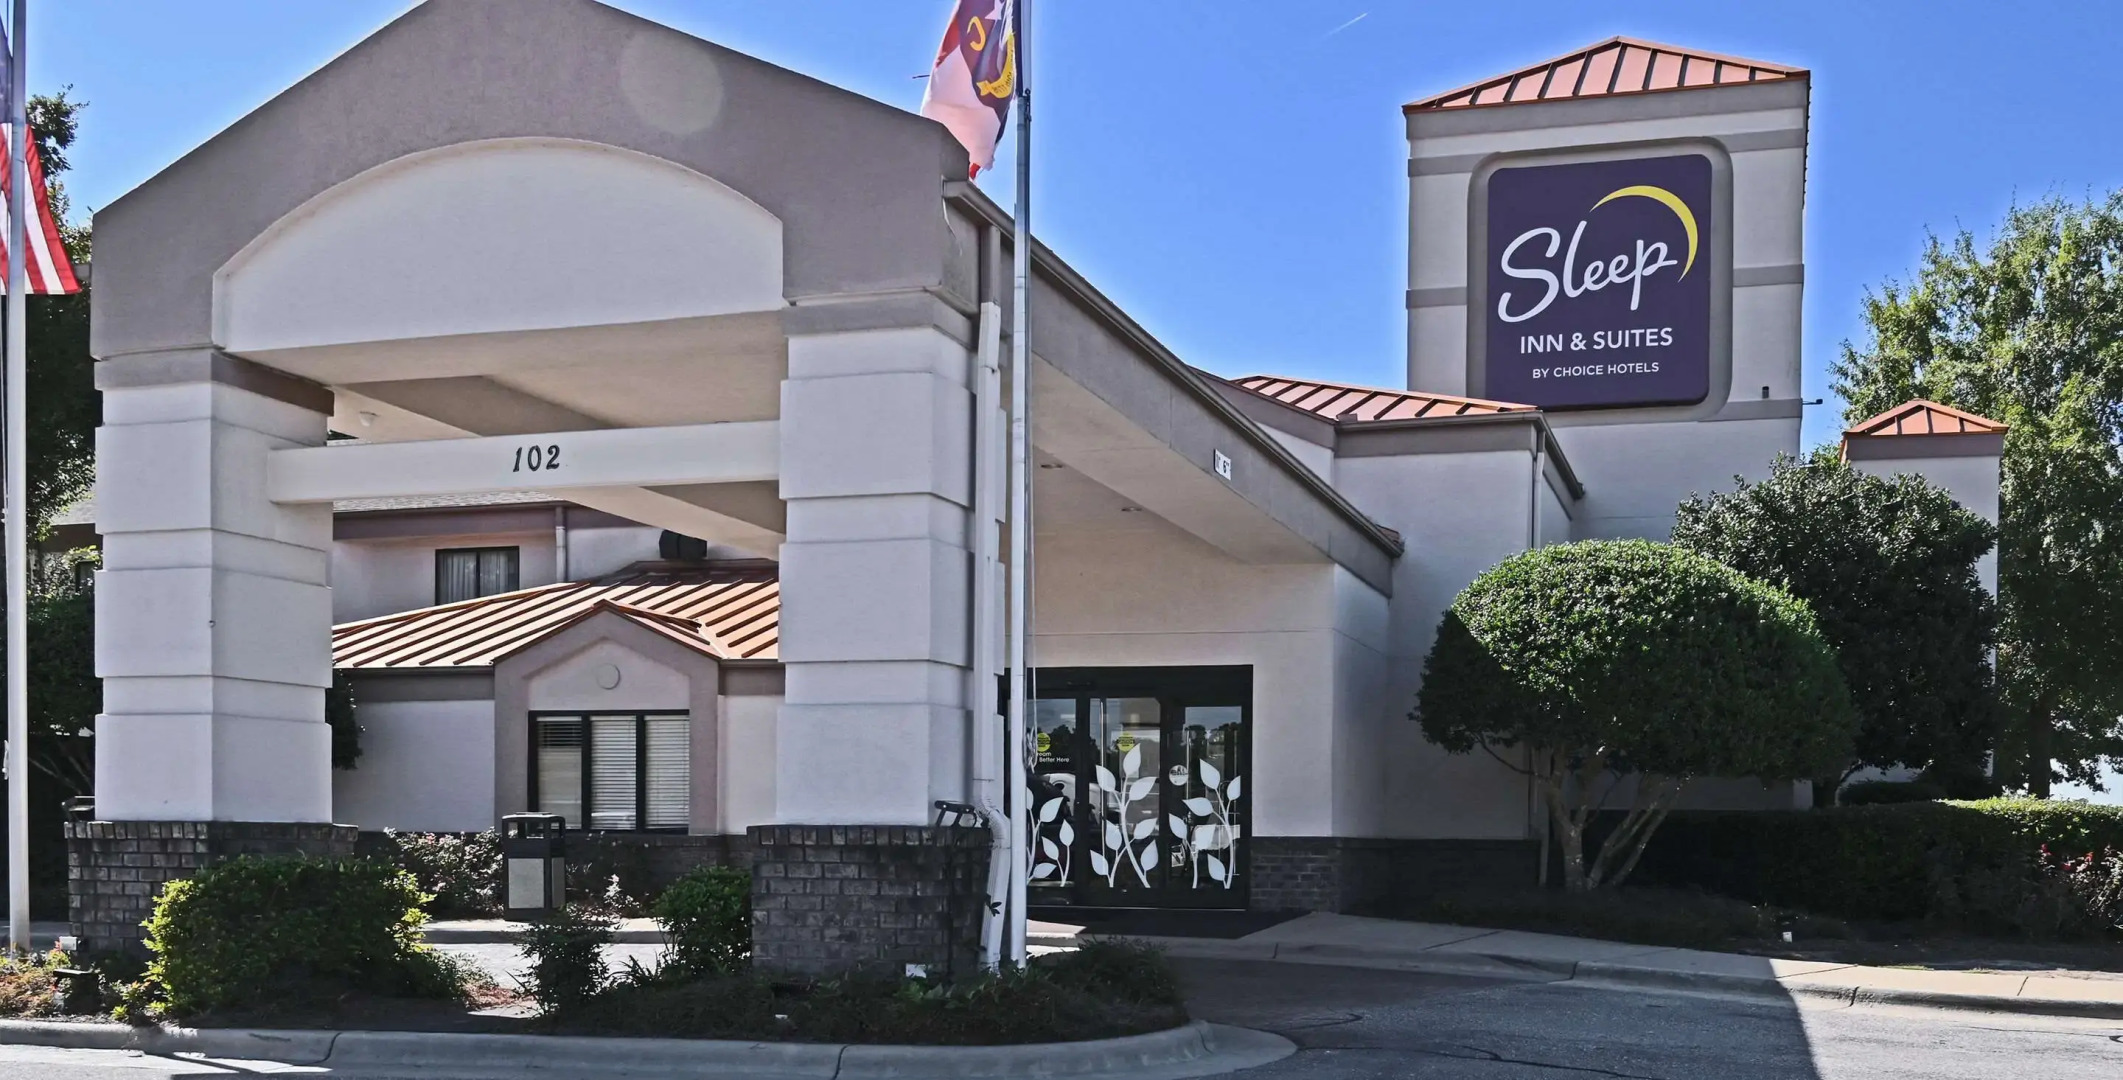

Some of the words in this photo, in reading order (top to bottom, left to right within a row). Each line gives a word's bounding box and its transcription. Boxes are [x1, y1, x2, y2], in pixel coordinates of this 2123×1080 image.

[1497, 220, 1678, 323] Sleep
[1520, 333, 1563, 354] INN
[1569, 332, 1587, 351] &
[1592, 327, 1673, 350] SUITES
[1532, 367, 1549, 379] BY
[1553, 364, 1604, 378] CHOICE
[1607, 361, 1660, 375] HOTELS
[512, 444, 560, 472] 102
